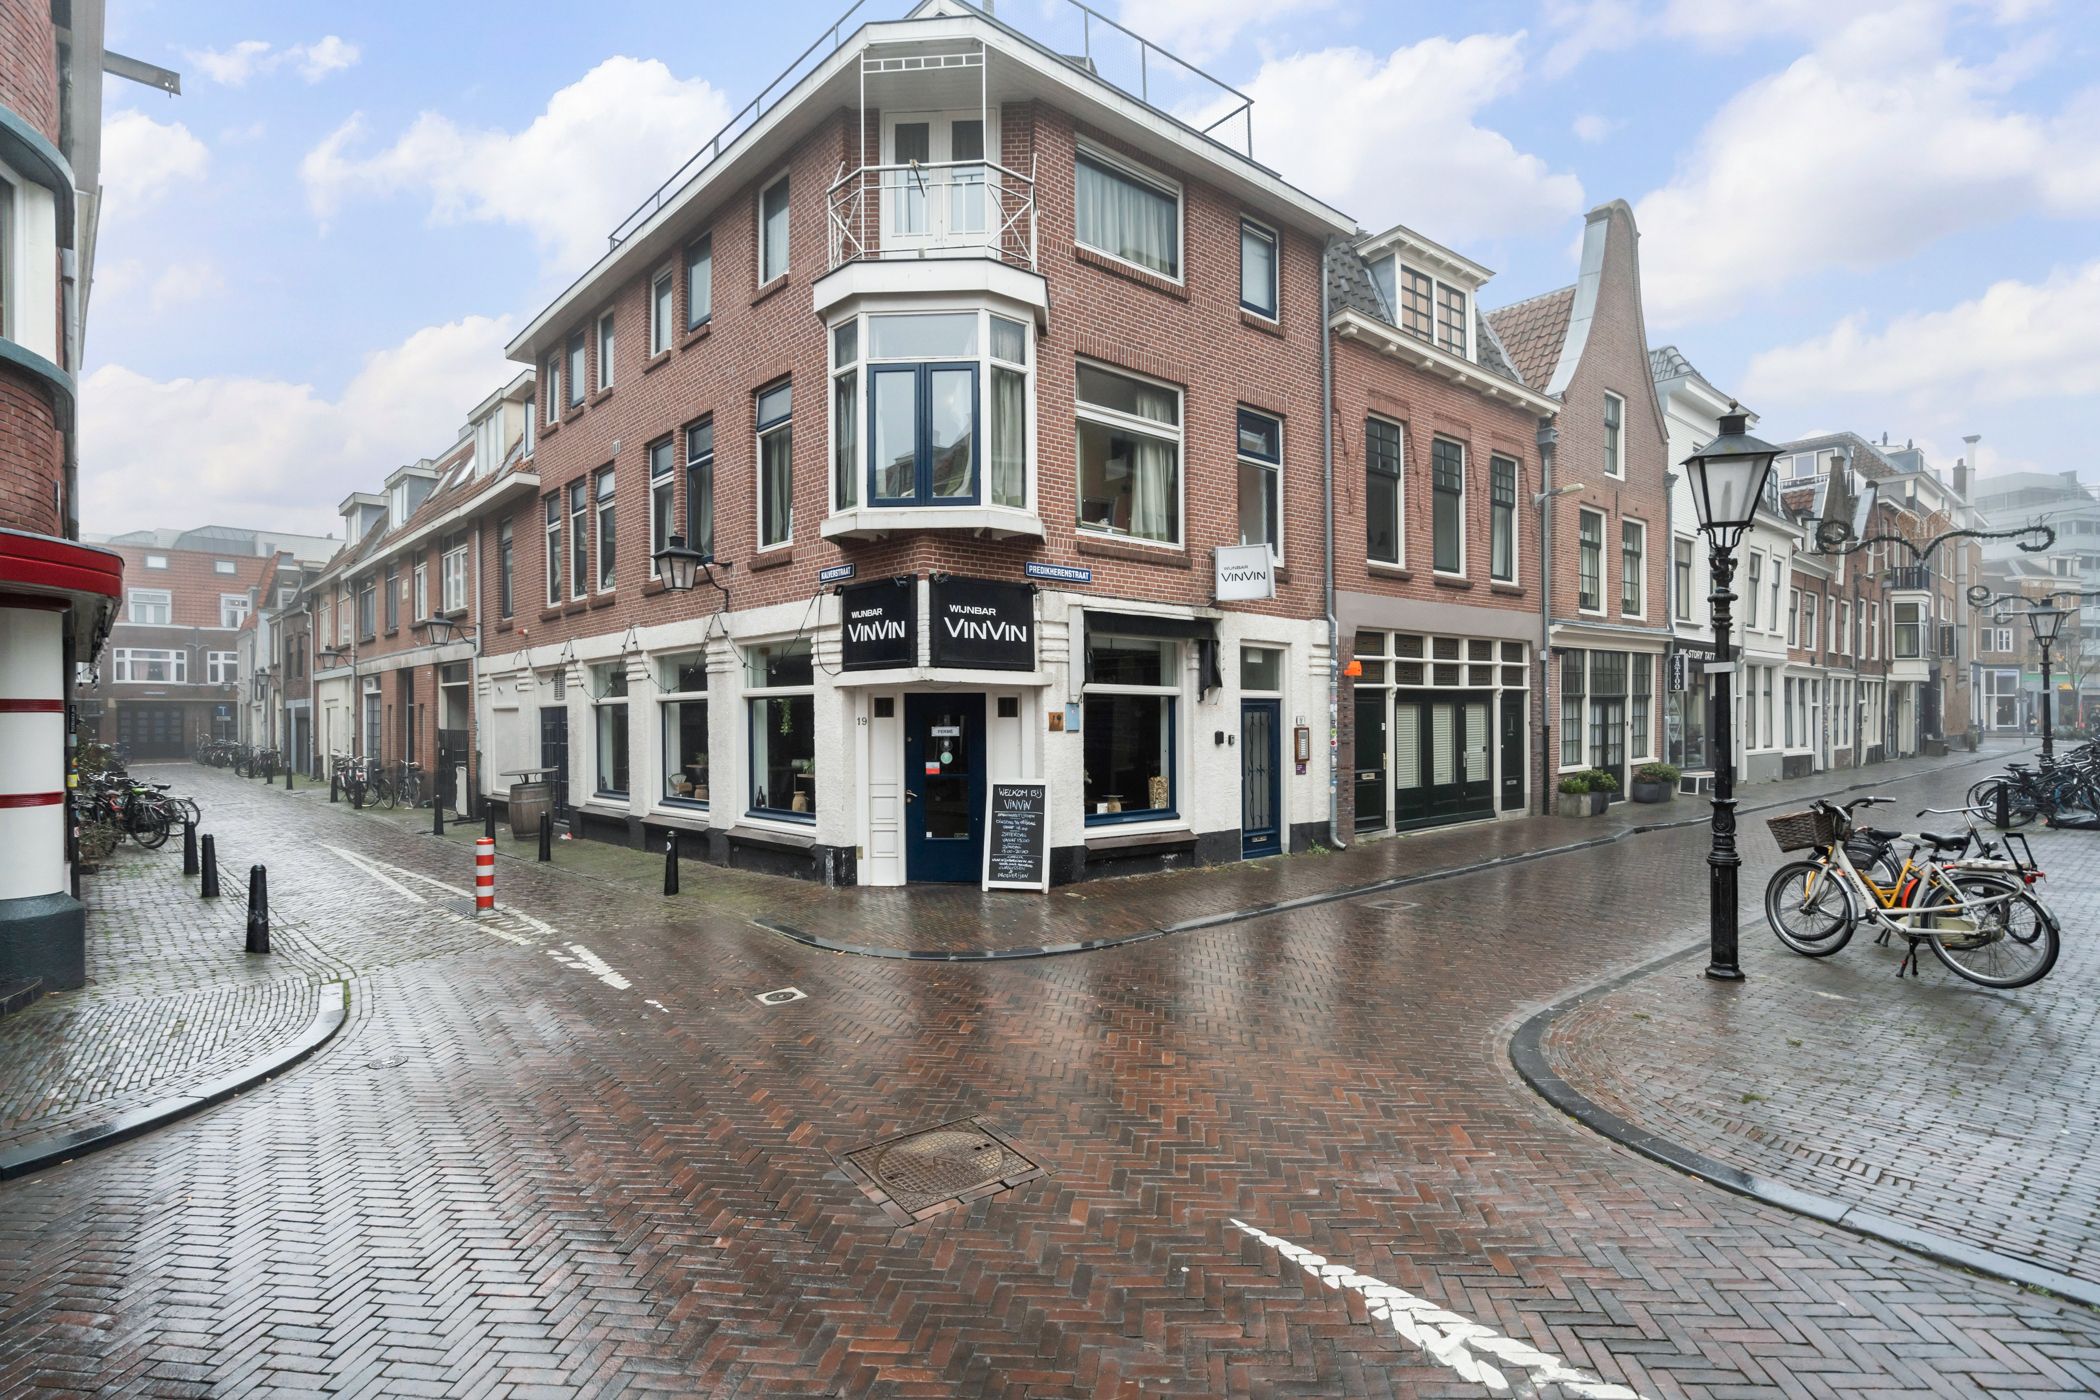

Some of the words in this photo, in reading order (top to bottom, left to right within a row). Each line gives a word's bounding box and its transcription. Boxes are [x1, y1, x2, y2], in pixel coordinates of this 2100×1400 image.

[821, 566, 851, 580] KALVERSTRAAT
[1028, 565, 1089, 580] PREDIKHERENSTRAAT
[1221, 571, 1266, 582] VINVIN
[851, 607, 883, 619] WIJNBAR
[949, 604, 996, 616] WIJNBAR
[848, 619, 906, 643] VINVIN
[944, 616, 1027, 643] VINVIN
[1688, 649, 1703, 660] STORY
[1705, 651, 1716, 661] TATT
[857, 716, 867, 726] 19
[999, 787, 1028, 797] WELKOM
